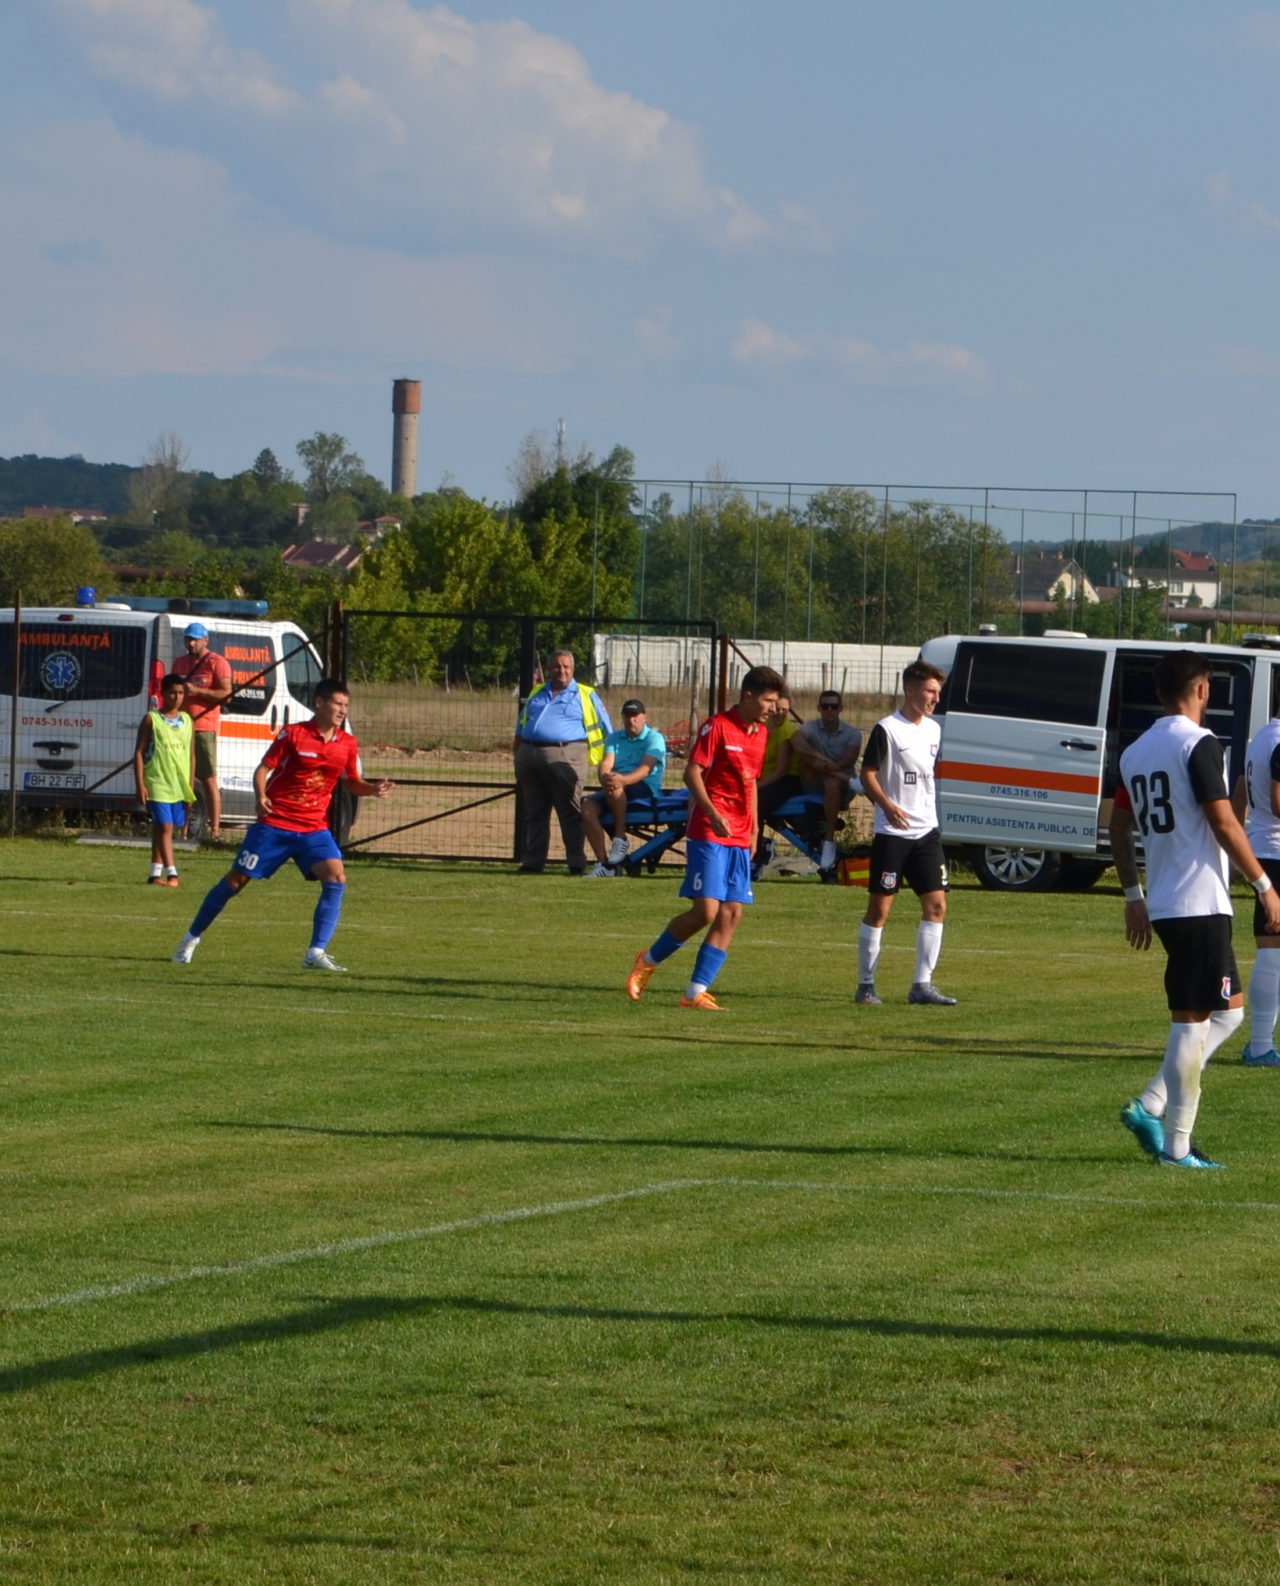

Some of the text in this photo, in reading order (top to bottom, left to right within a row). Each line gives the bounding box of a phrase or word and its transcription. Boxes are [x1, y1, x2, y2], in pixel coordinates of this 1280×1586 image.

[22, 716, 93, 728] 0745-316.106
[31, 775, 45, 786] BH
[49, 776, 61, 786] 22
[990, 786, 1048, 800] 0745.316.106
[1131, 771, 1176, 836] 23
[947, 813, 1095, 837] PENTRU ASISTENTA PUBLICA DE
[238, 849, 260, 871] 30
[693, 872, 703, 891] 6
